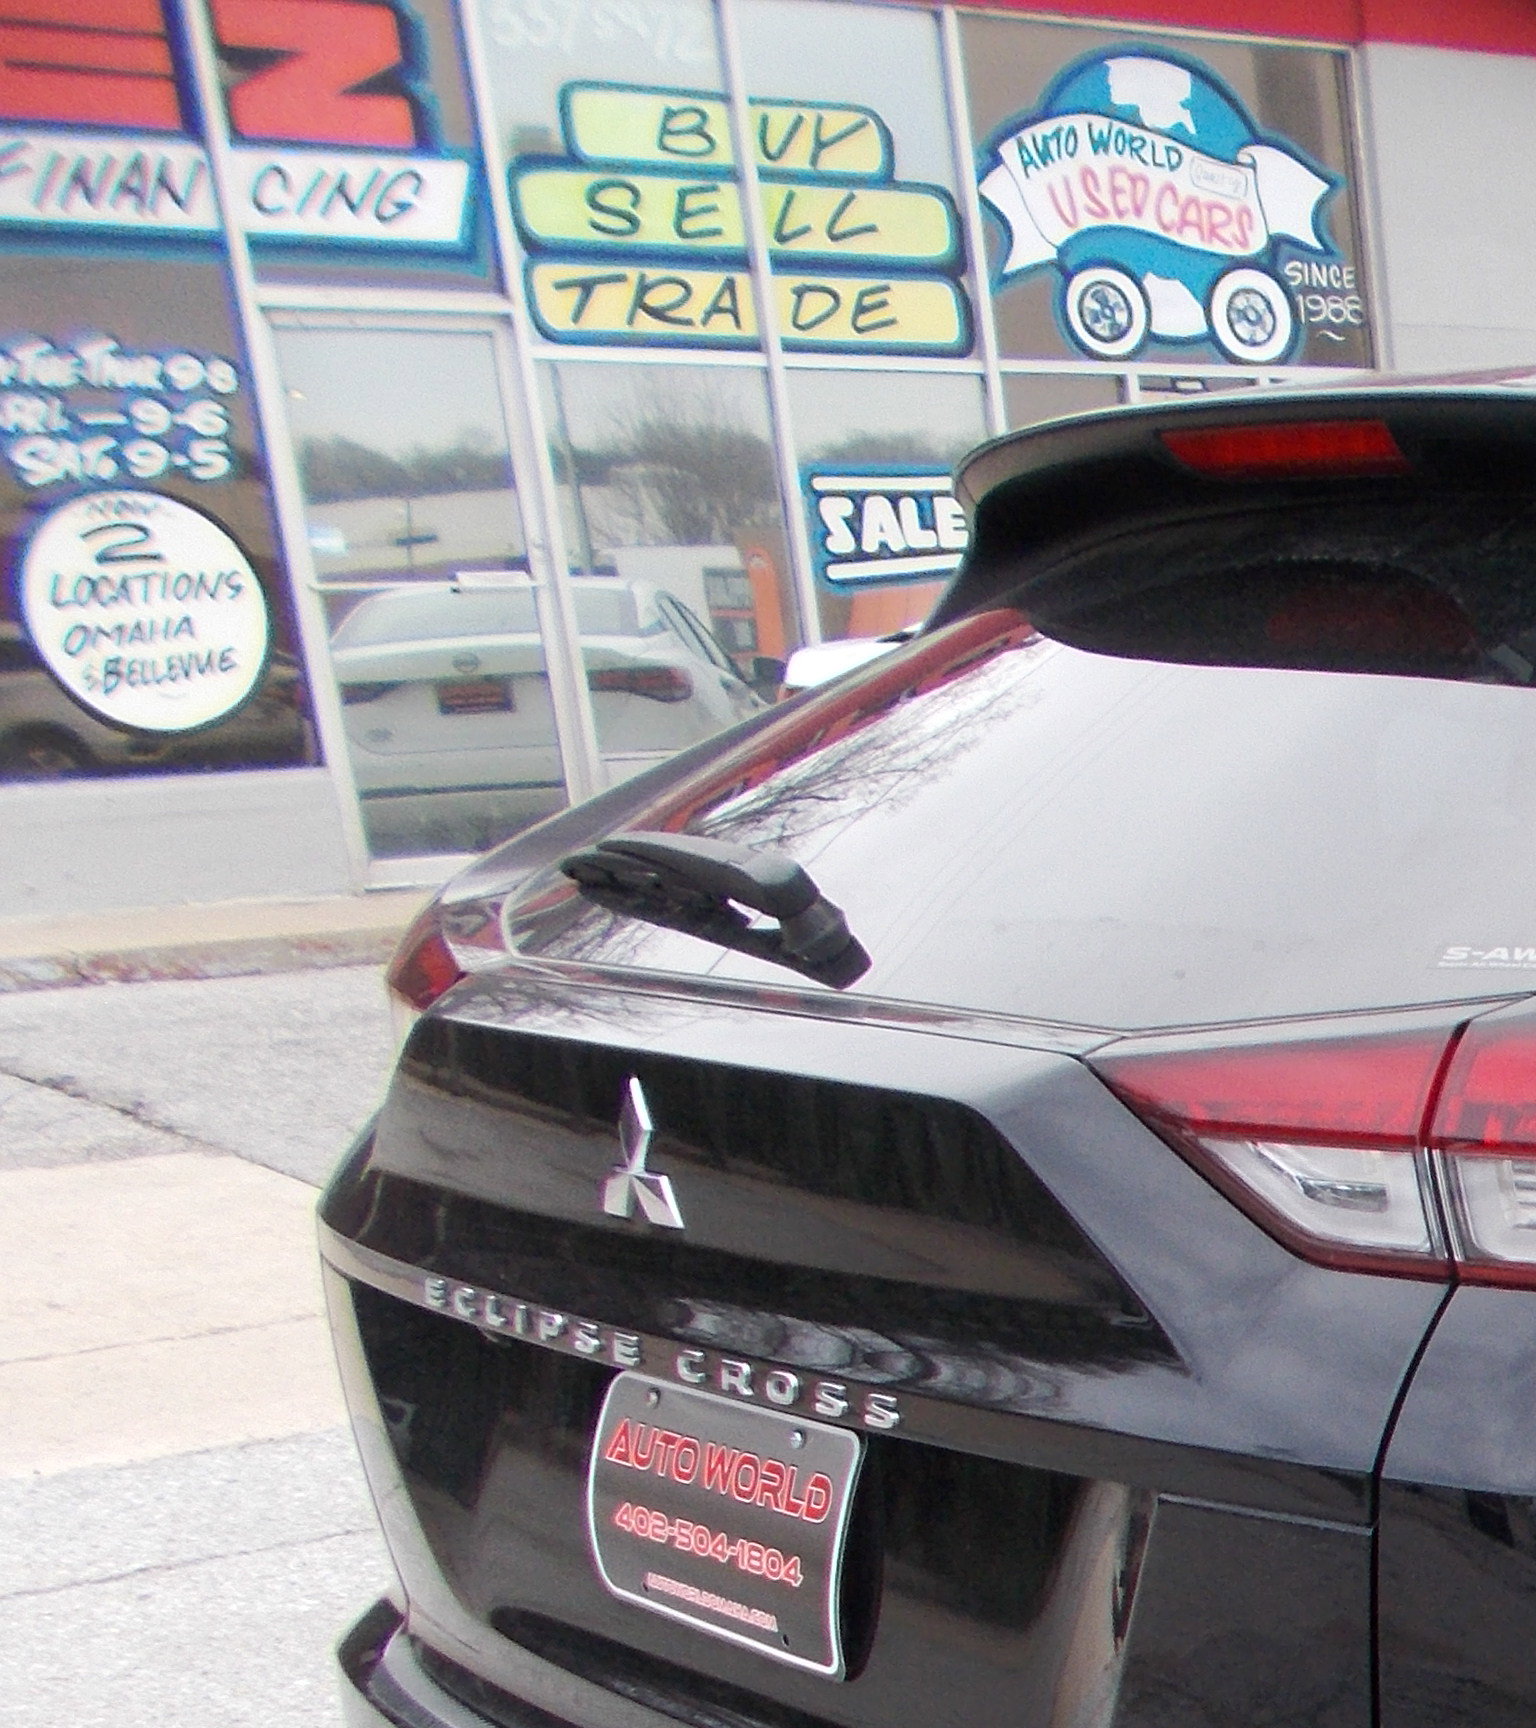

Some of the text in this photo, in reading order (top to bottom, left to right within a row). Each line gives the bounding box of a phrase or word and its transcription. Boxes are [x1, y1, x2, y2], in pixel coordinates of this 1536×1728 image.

[655, 105, 870, 169] BUY
[1015, 121, 1184, 178] AUTO WORLD
[585, 178, 878, 244] SELL
[1047, 164, 1150, 230] USED
[1154, 181, 1254, 250] CARS
[553, 272, 898, 334] TRADE
[1283, 259, 1356, 290] SINCE
[79, 522, 165, 565] 2
[819, 496, 969, 554] SALE
[48, 568, 245, 608] LOCATIONS
[61, 613, 196, 656] OMAHA
[103, 646, 236, 694] BELLEVUE
[424, 1279, 901, 1430] ECLIPSE CROSS
[605, 1417, 833, 1525] AUTO WORLD
[614, 1502, 804, 1588] 402-504-1804
